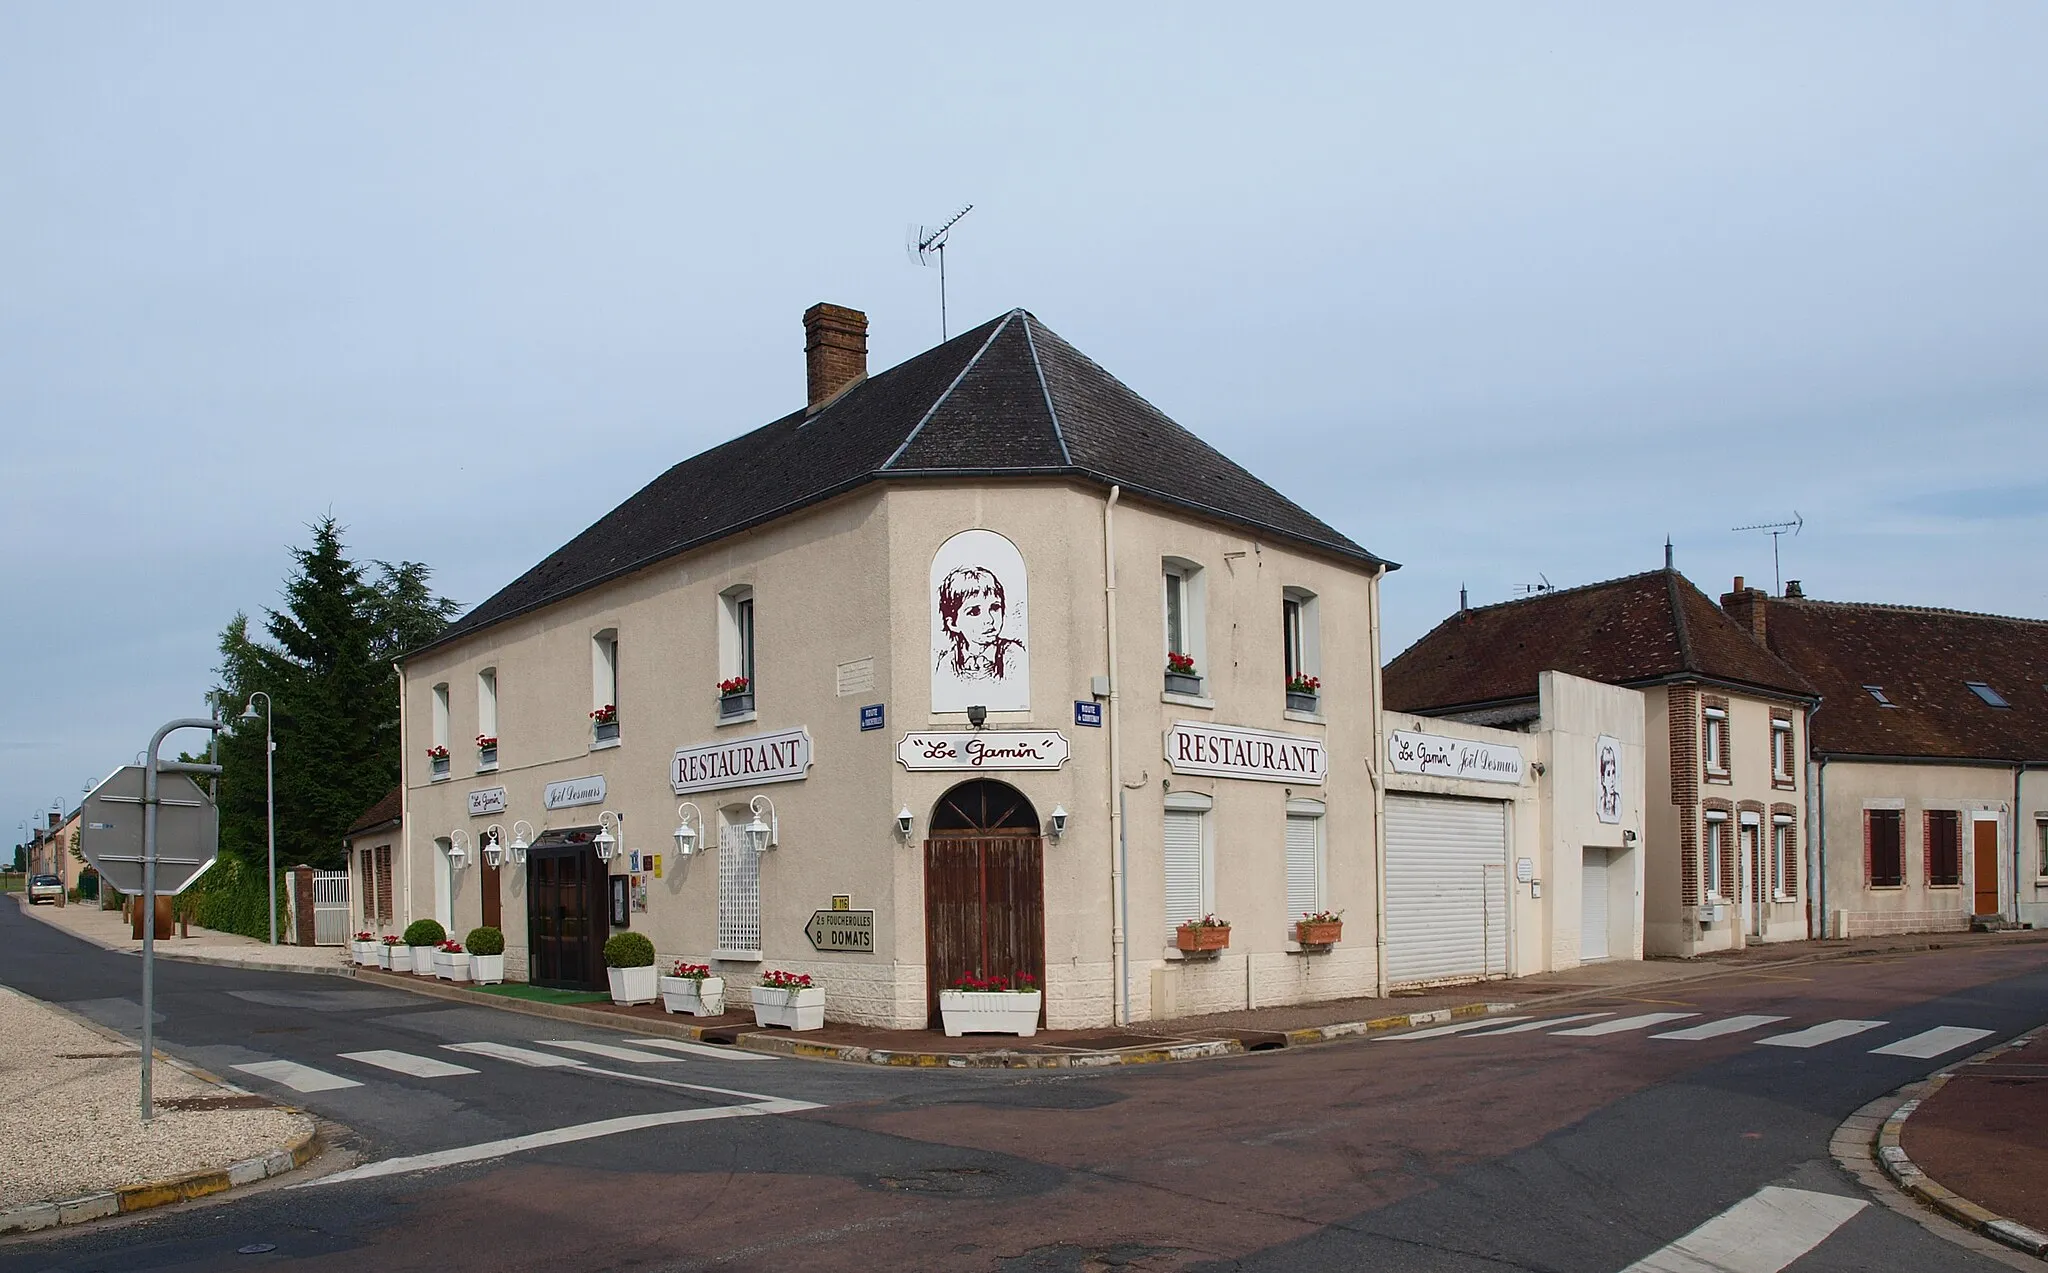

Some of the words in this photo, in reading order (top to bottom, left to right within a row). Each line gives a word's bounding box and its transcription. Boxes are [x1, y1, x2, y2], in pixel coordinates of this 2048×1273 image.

[677, 739, 800, 783] RESTAURANT
[1177, 732, 1320, 773] RESTAURANT
[826, 915, 871, 927] FOUCHEROLLES
[816, 930, 822, 945] 8
[831, 930, 870, 947] DOMATS
